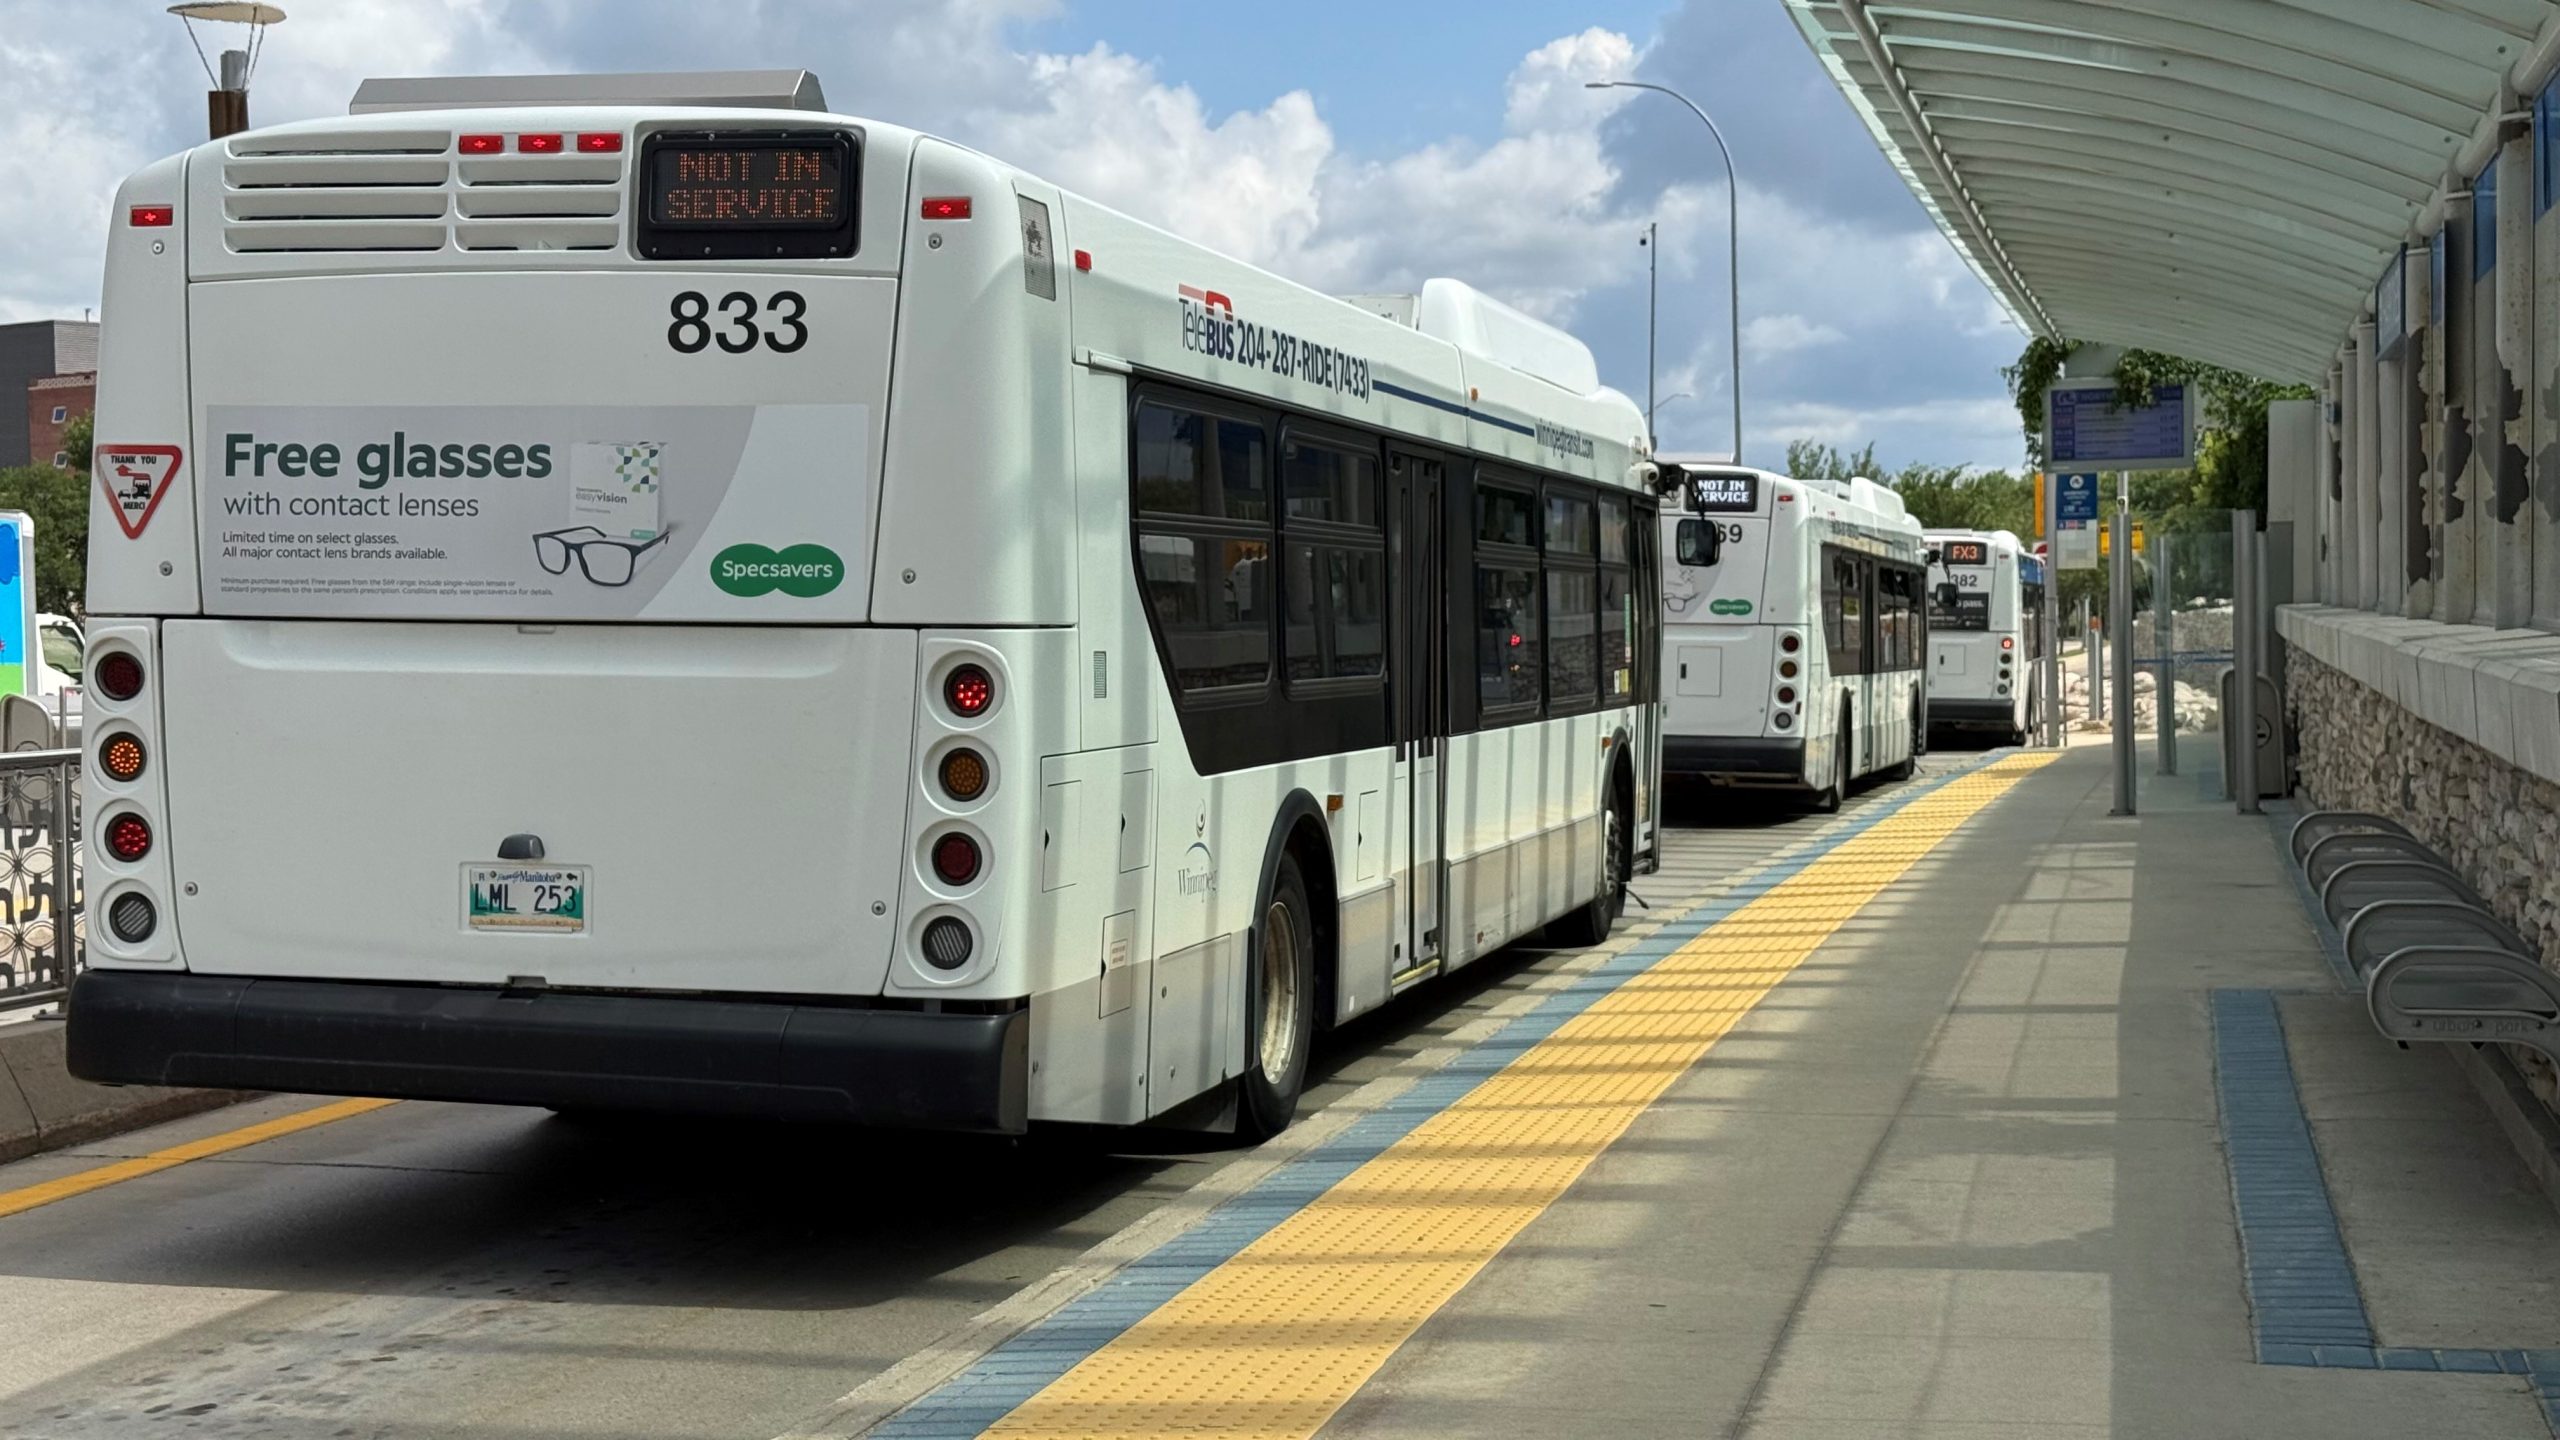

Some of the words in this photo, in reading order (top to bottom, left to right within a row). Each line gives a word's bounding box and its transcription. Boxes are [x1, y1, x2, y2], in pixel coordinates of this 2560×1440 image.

[680, 152, 756, 181] NOT
[775, 152, 821, 181] IN
[668, 189, 834, 218] SERVICE
[668, 290, 808, 354] 833
[1179, 298, 1234, 361] TeleBUS
[111, 455, 136, 464] THANK
[141, 455, 157, 464] YOU
[225, 433, 341, 478] Free
[356, 431, 552, 490] glasses
[1698, 480, 1725, 491] NOT
[1729, 480, 1745, 491] IN
[123, 502, 145, 510] MERCI
[224, 491, 280, 515] with
[289, 494, 390, 516] contact
[399, 492, 479, 517] lenses
[223, 531, 265, 543] Limited
[268, 531, 295, 543] time
[297, 534, 313, 543] on
[316, 532, 351, 544] select
[354, 532, 399, 546] glasses.
[222, 546, 237, 557] All
[240, 546, 273, 560] major
[276, 547, 321, 558] contact
[324, 547, 348, 559] lens
[351, 547, 392, 559] brands
[395, 547, 448, 559] available.
[1952, 545, 1978, 559] FX3
[722, 559, 833, 581] Specsavers
[519, 870, 556, 883] Manitoba
[475, 883, 517, 912] LML
[534, 885, 576, 912] 253
